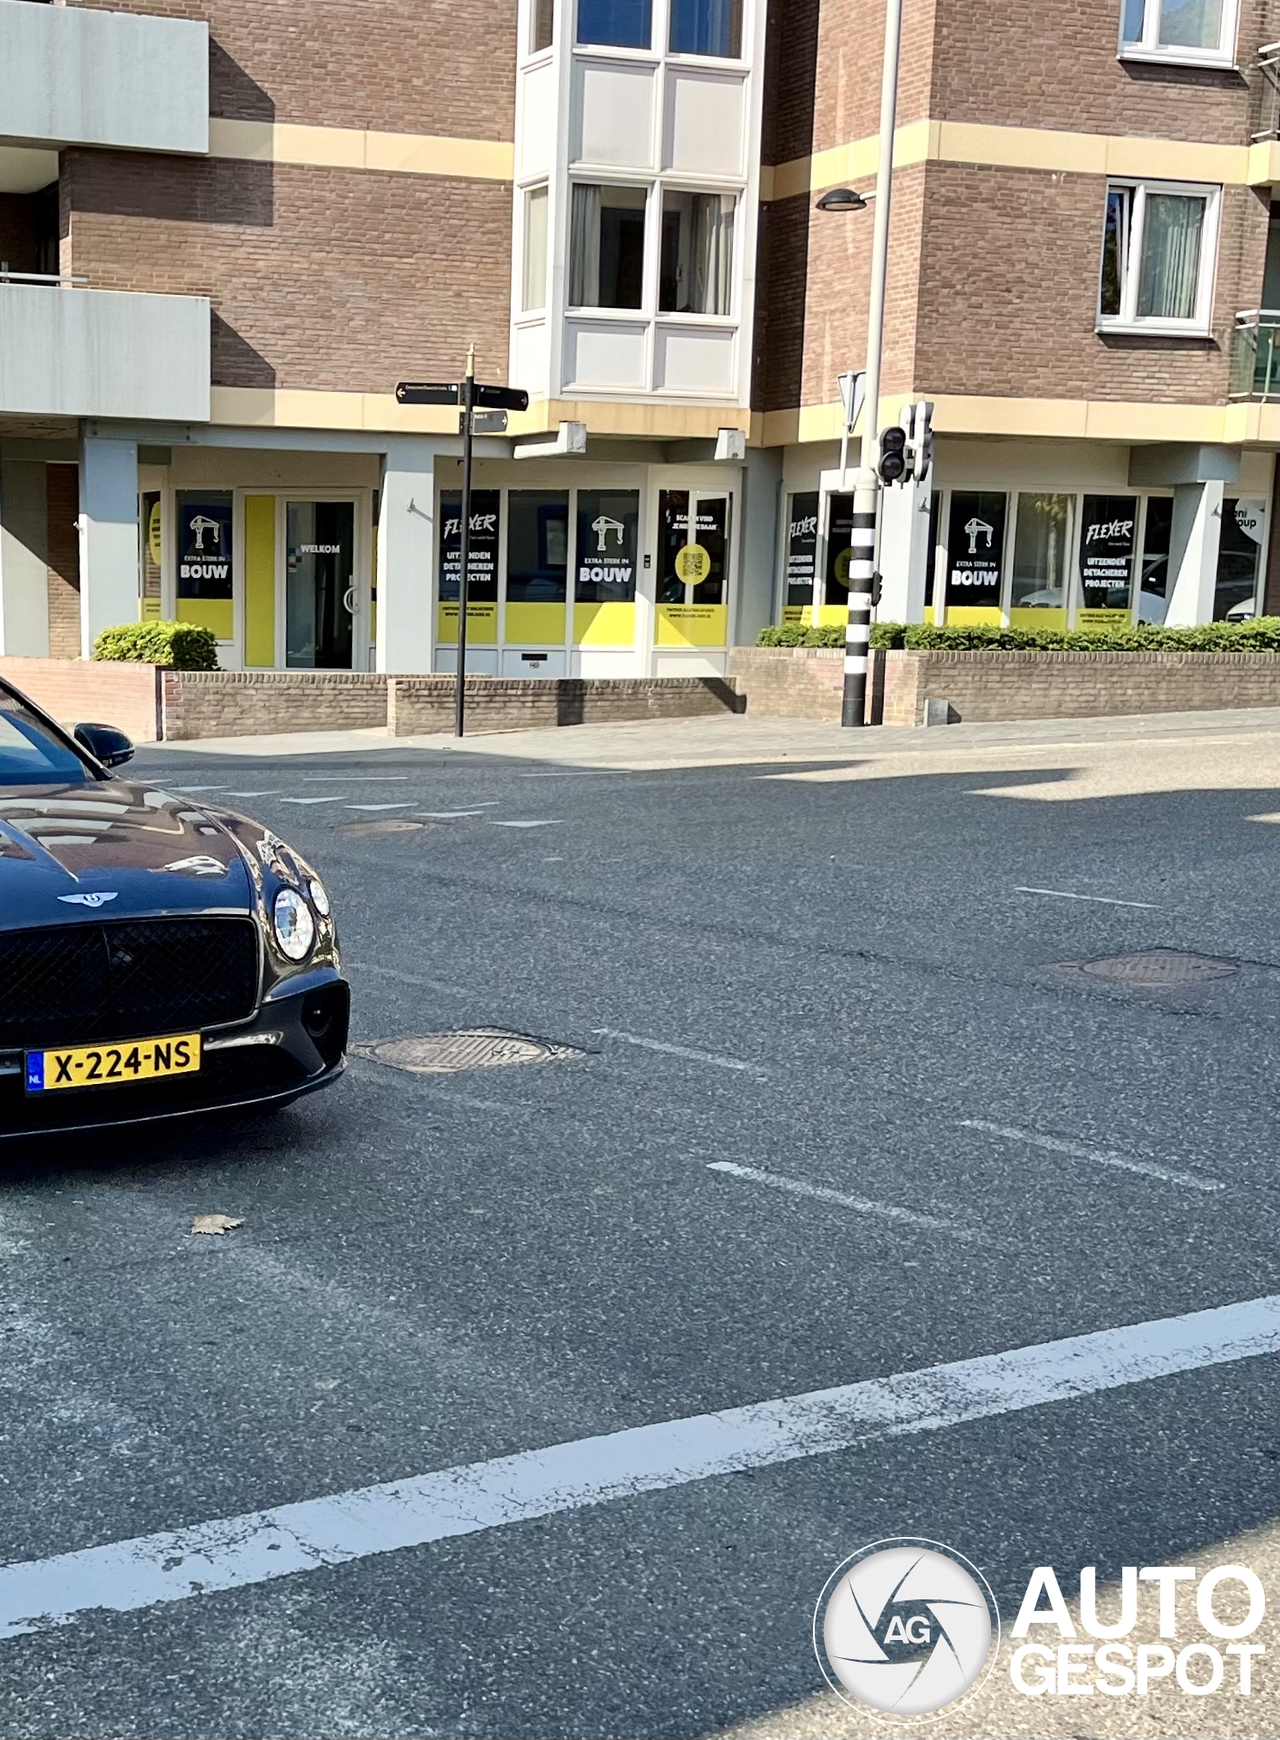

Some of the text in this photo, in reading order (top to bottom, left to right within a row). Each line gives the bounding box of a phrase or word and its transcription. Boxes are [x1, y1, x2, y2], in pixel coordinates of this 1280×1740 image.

[443, 513, 497, 539] FLXER
[1085, 519, 1133, 545] FLEXER
[300, 544, 340, 554] WELKOM
[180, 564, 229, 579] BOUW
[579, 567, 632, 583] BOUW
[951, 570, 999, 586] BOUW
[1085, 579, 1125, 588] PROJECTEN
[29, 1041, 191, 1084] NL X-224-NS
